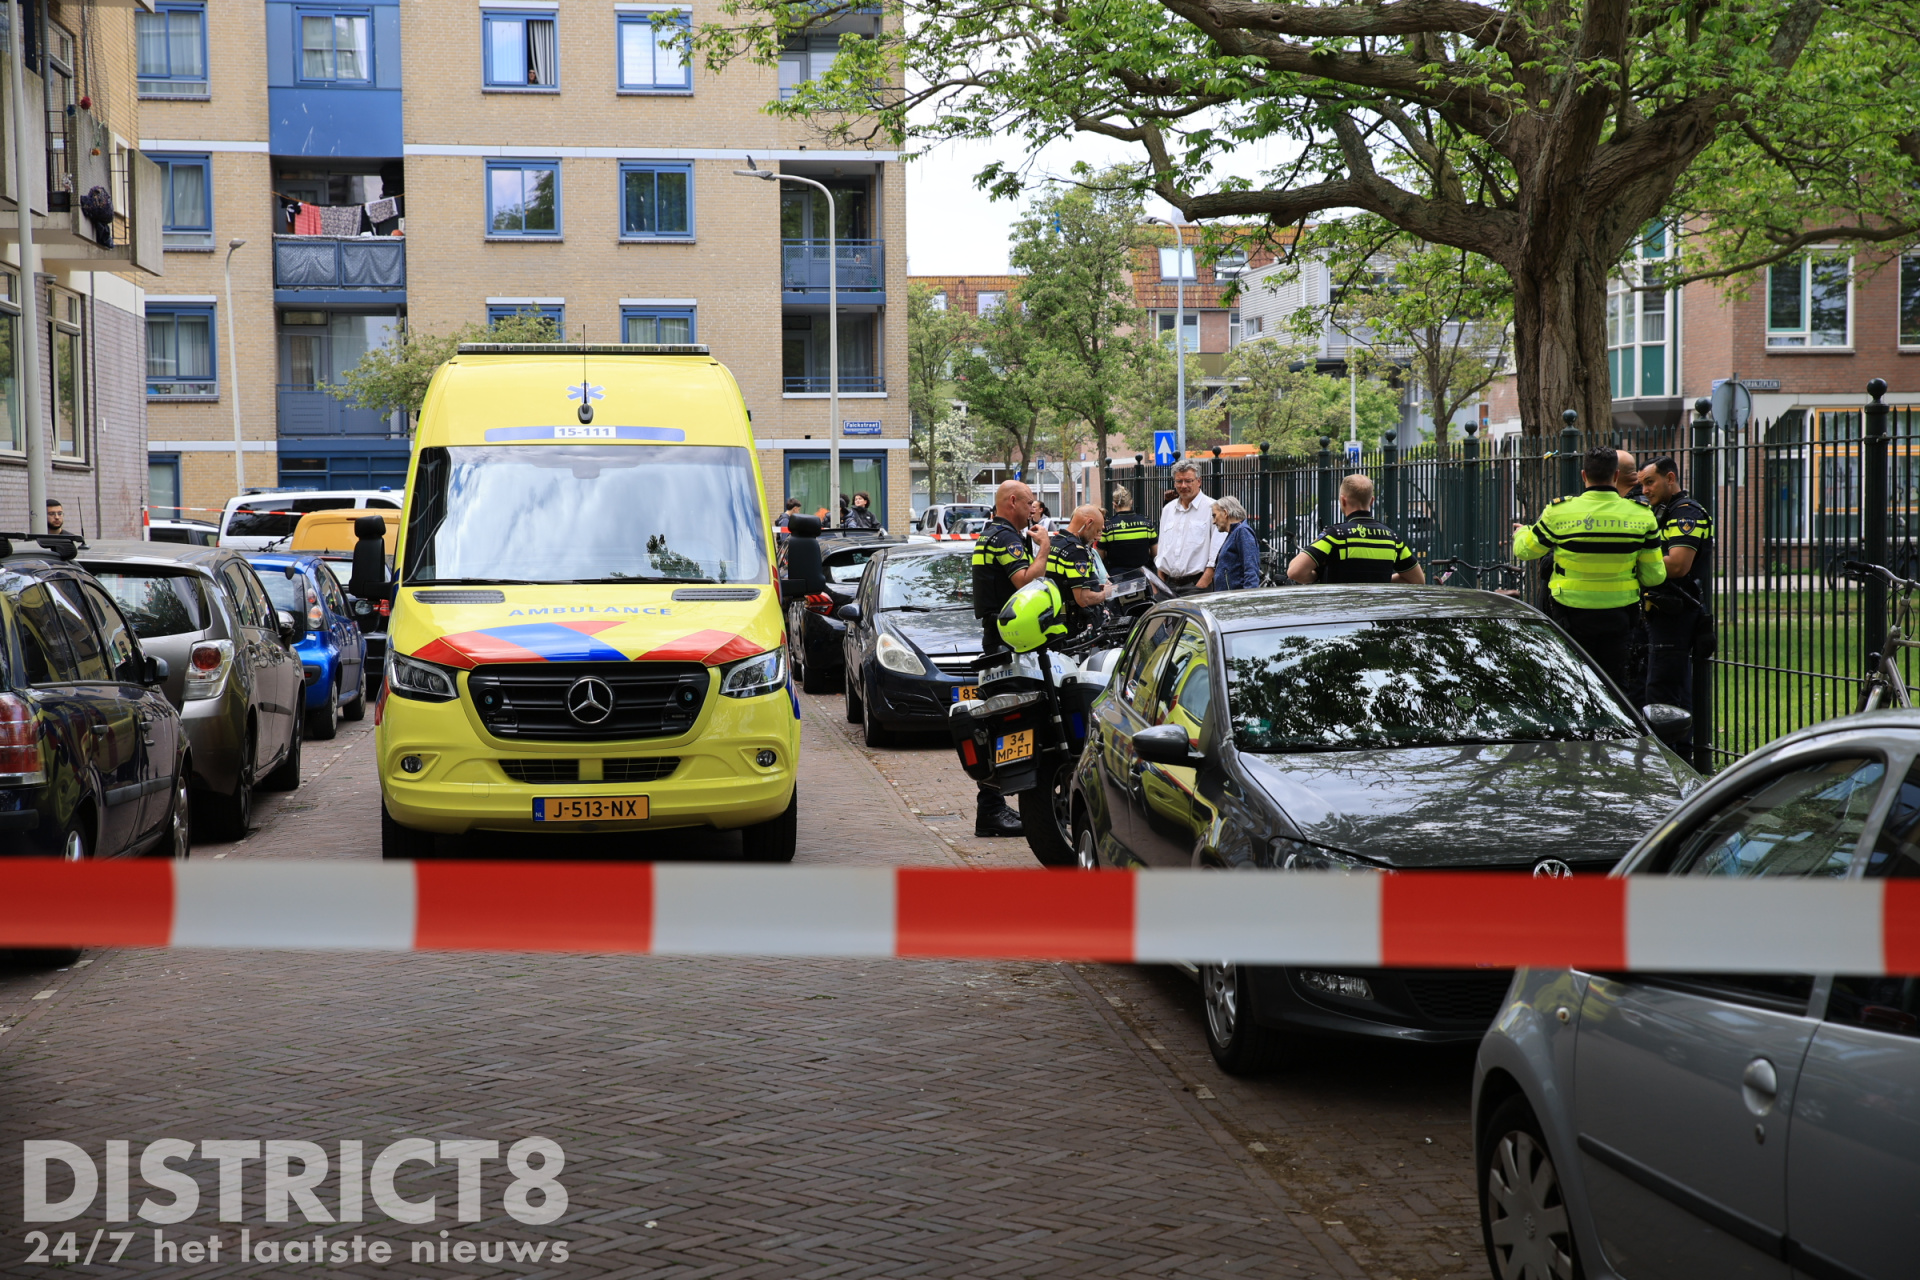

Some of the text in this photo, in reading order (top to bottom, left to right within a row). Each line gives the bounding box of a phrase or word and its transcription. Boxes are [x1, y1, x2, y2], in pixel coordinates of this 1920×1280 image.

[558, 428, 610, 436] 15-111
[508, 606, 672, 617] AMBULANCE
[981, 668, 1013, 683] POLITIE
[1053, 665, 1063, 674] 12
[1010, 732, 1024, 746] 34
[997, 743, 1031, 762] MP-FT
[553, 800, 637, 818] J-513-NX
